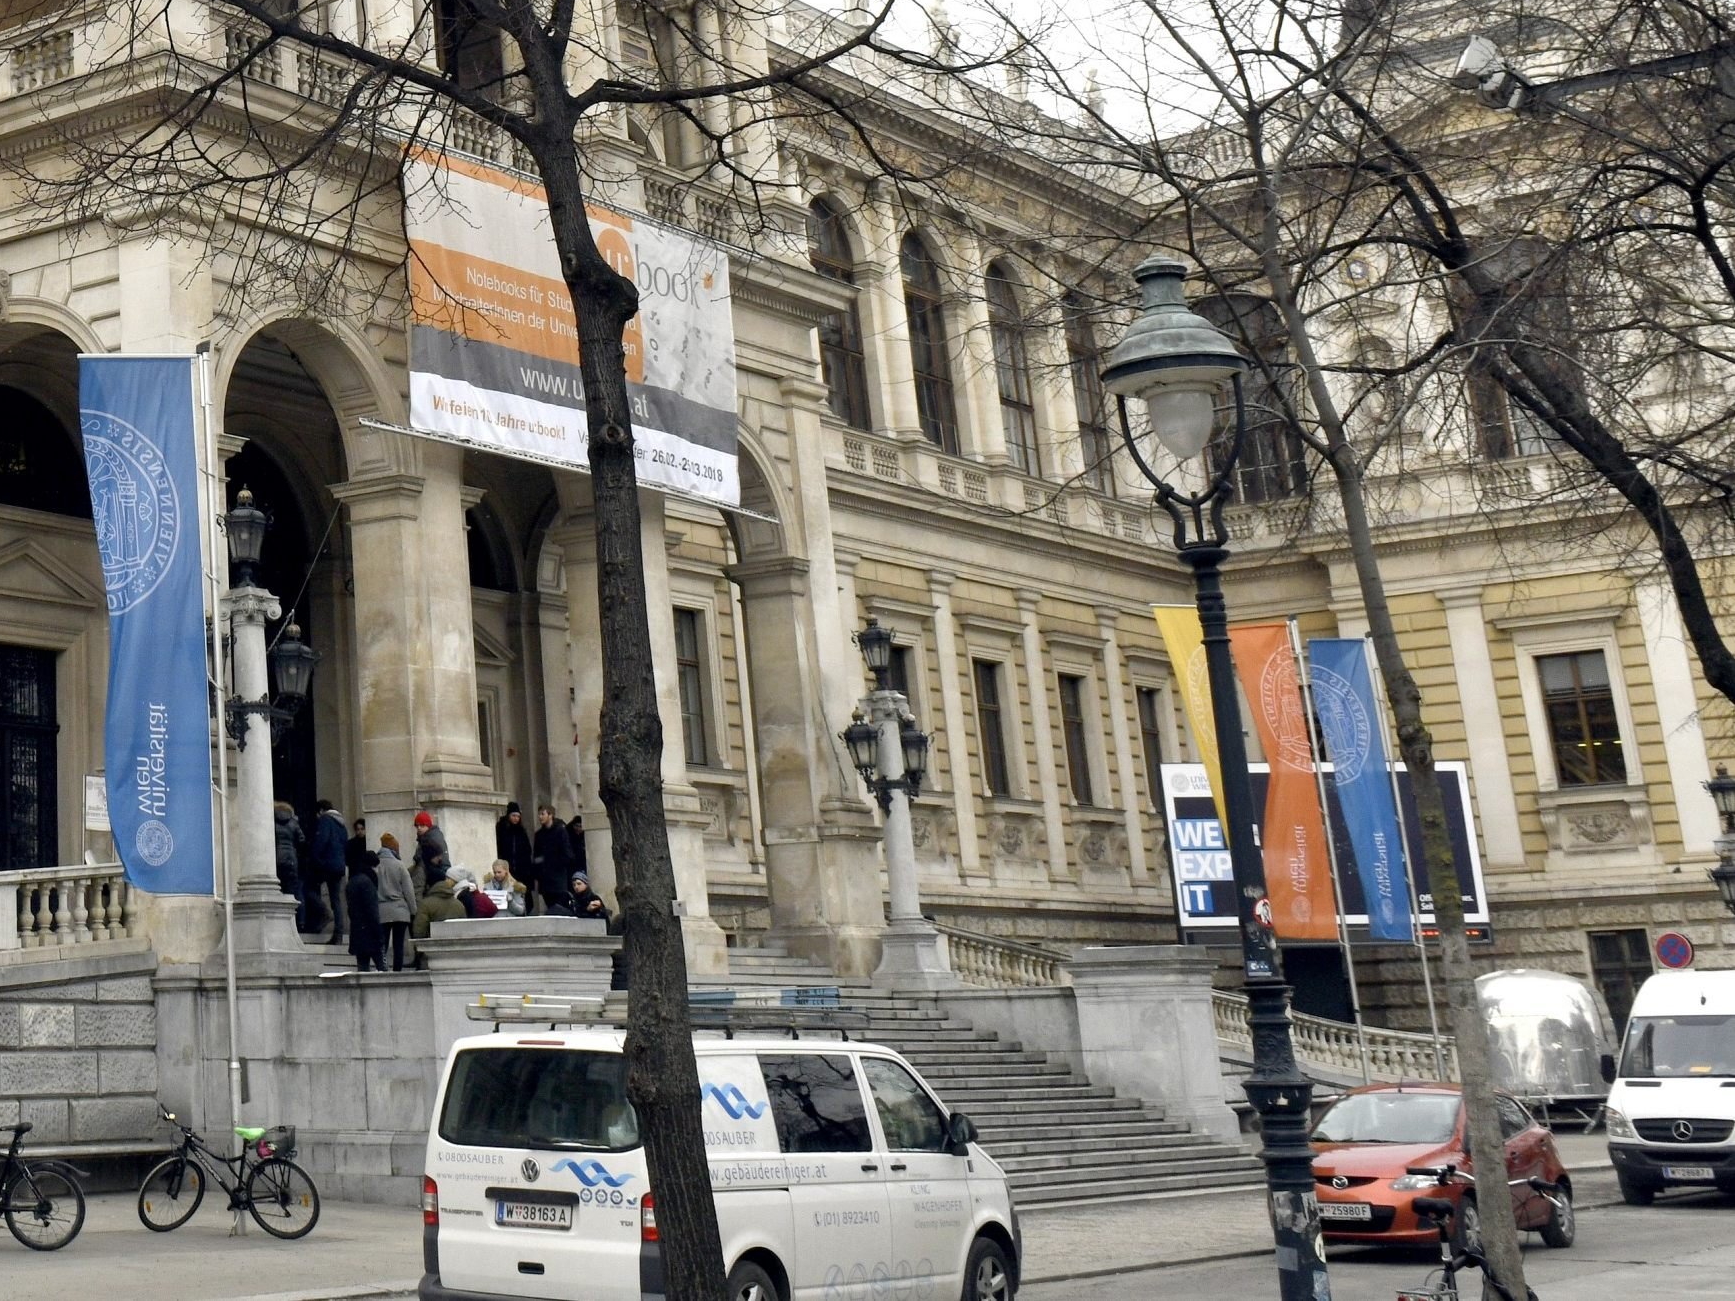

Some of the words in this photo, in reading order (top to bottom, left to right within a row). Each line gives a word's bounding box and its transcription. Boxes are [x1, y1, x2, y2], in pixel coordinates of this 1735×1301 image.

[467, 267, 527, 300] Notebooks
[529, 285, 544, 304] für
[528, 311, 545, 331] der
[495, 412, 526, 431] Jahre
[1174, 821, 1223, 847] WE
[1182, 885, 1209, 911] IT
[446, 1152, 505, 1165] 0800SAUBER
[506, 1205, 517, 1218] W
[523, 1206, 556, 1222] 38163
[559, 1209, 566, 1222] A
[823, 1213, 840, 1227] (01)
[842, 1210, 880, 1225] 8923410
[1331, 1206, 1360, 1216] 25980
